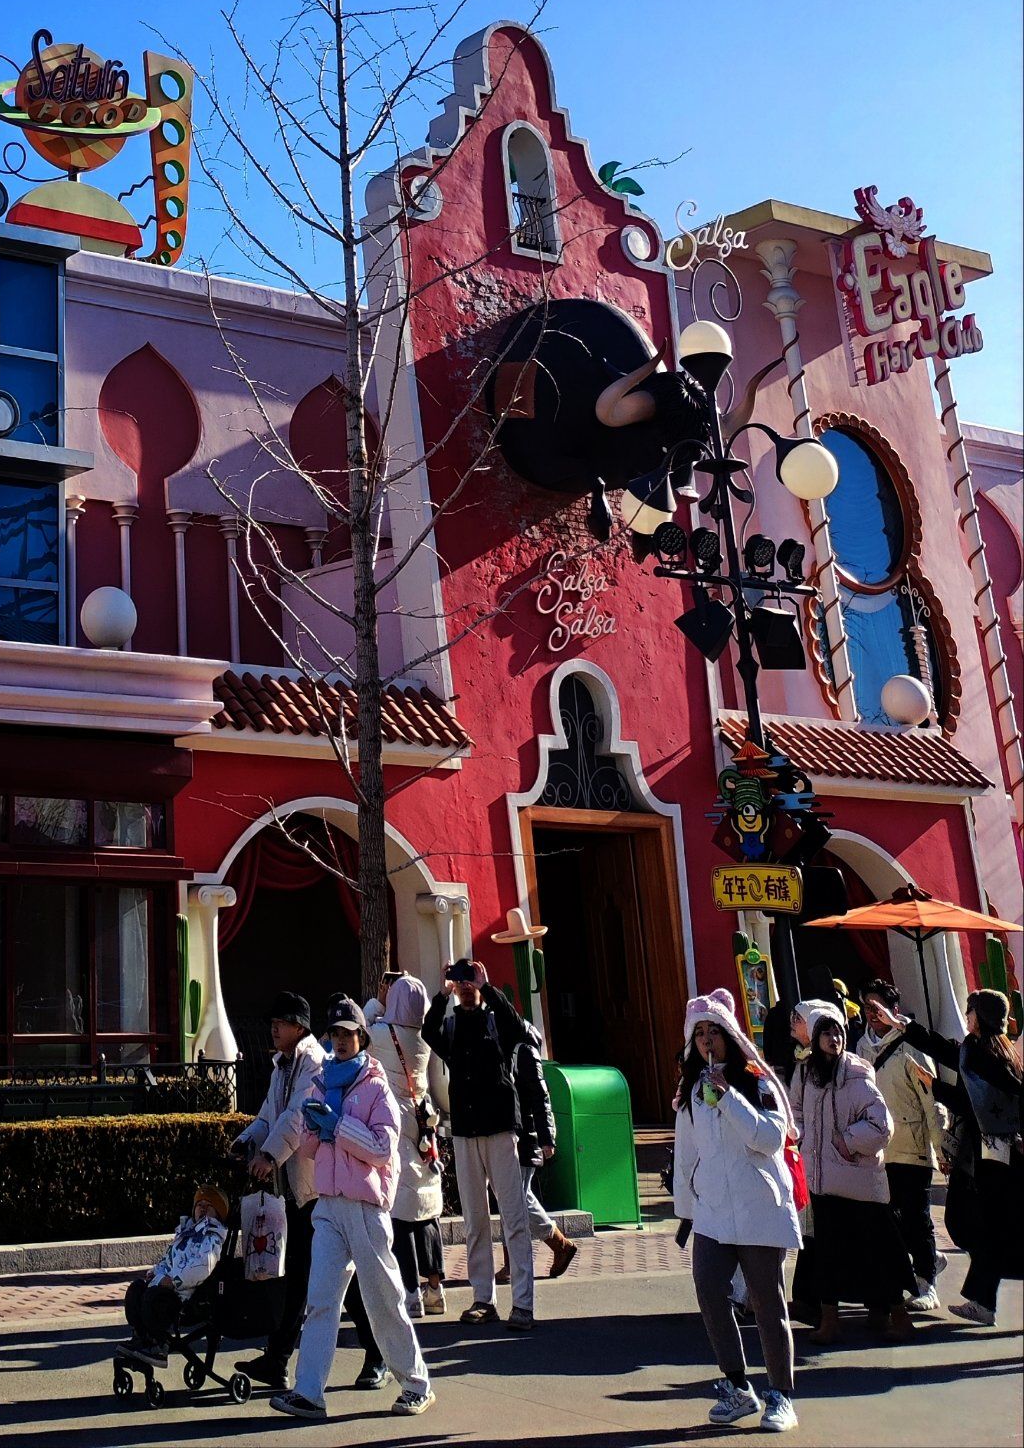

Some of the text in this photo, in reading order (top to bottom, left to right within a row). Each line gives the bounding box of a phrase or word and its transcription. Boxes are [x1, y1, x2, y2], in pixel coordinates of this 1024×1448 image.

[27, 28, 131, 102] Saturn
[35, 100, 144, 127] FOOD
[666, 200, 749, 271] Salsa
[846, 232, 967, 359] Eagle
[865, 337, 919, 386] Hair
[939, 313, 984, 360] Club
[536, 551, 610, 614] Salsa
[547, 601, 618, 653] Salsa
[575, 603, 585, 615] &
